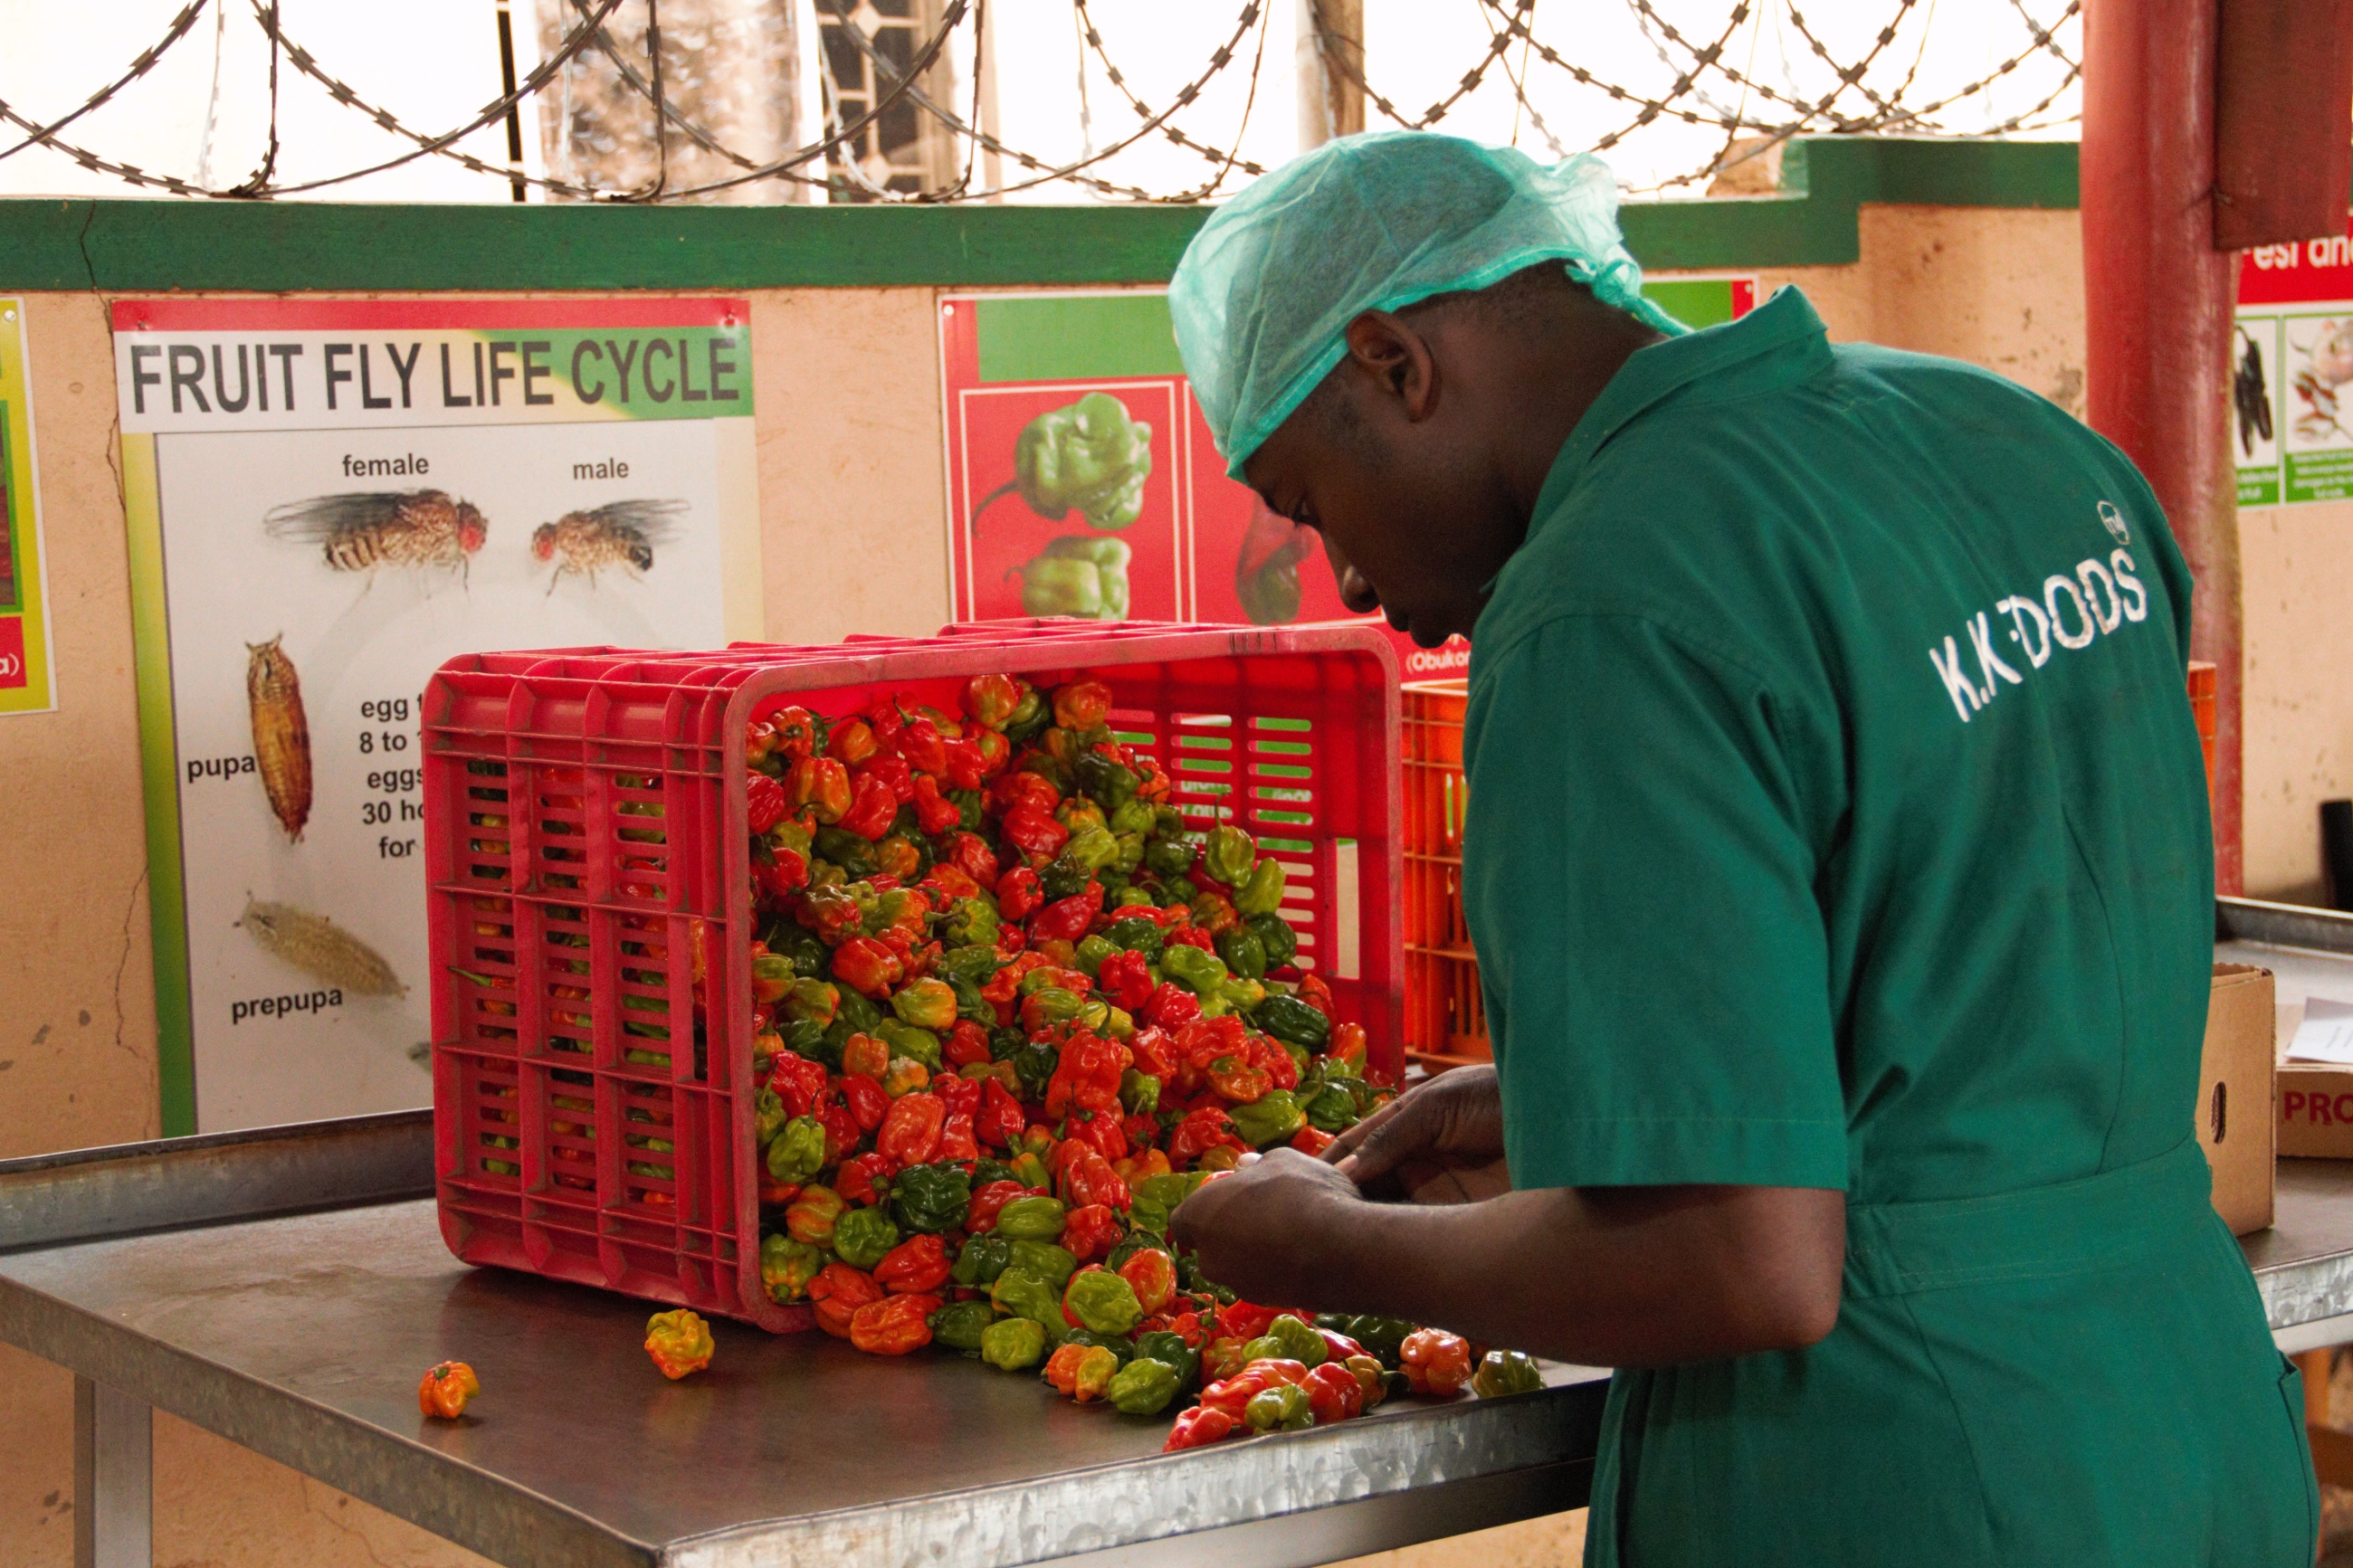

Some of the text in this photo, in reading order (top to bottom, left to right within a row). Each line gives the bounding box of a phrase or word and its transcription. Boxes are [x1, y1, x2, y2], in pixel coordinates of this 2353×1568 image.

[2307, 235, 2353, 269] an
[130, 337, 739, 413] FRUIT FLY LIFE CYCLE
[342, 452, 430, 477] female
[573, 457, 630, 480] male
[361, 698, 408, 723] egg
[359, 731, 374, 754] 8
[382, 731, 407, 752] to
[187, 755, 256, 784] pupa
[362, 801, 392, 825] 30
[379, 836, 416, 859] for
[232, 988, 343, 1025] prepupa
